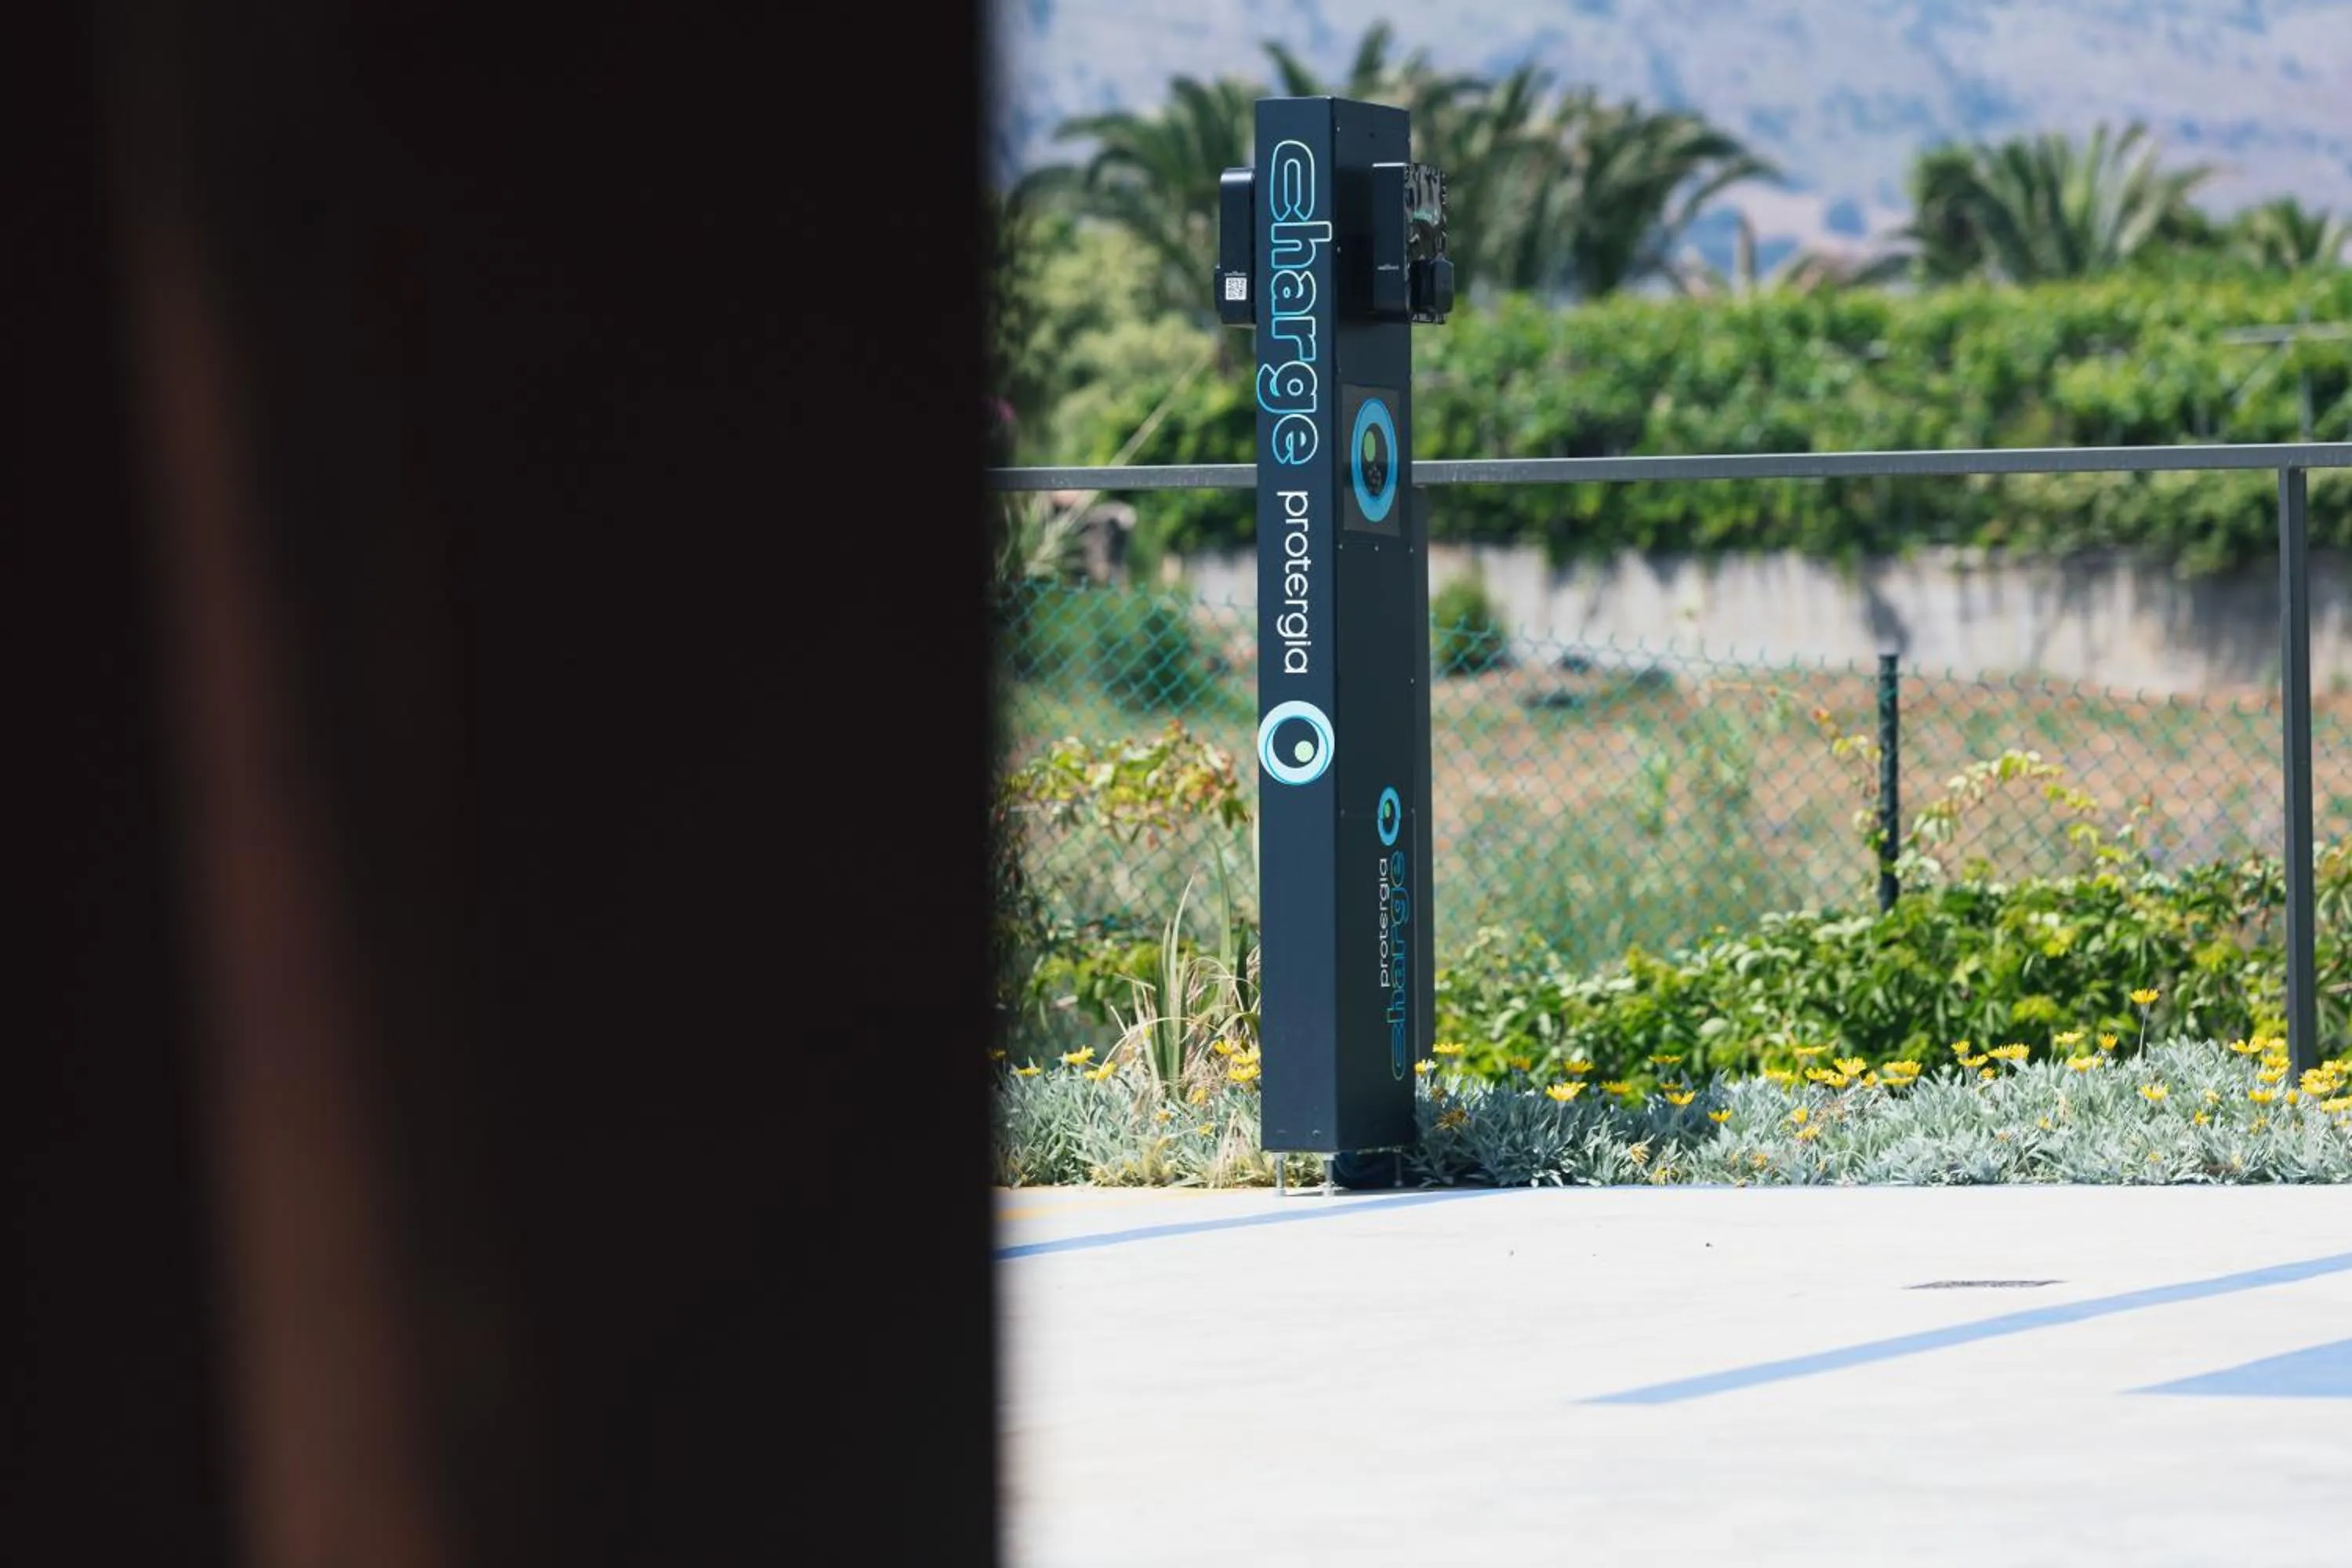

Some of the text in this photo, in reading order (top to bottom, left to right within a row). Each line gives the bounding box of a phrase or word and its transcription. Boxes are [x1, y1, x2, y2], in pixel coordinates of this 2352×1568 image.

[1257, 140, 1332, 673] charge protergia
[1379, 858, 1391, 988] protergia
[1387, 851, 1410, 1081] charge
